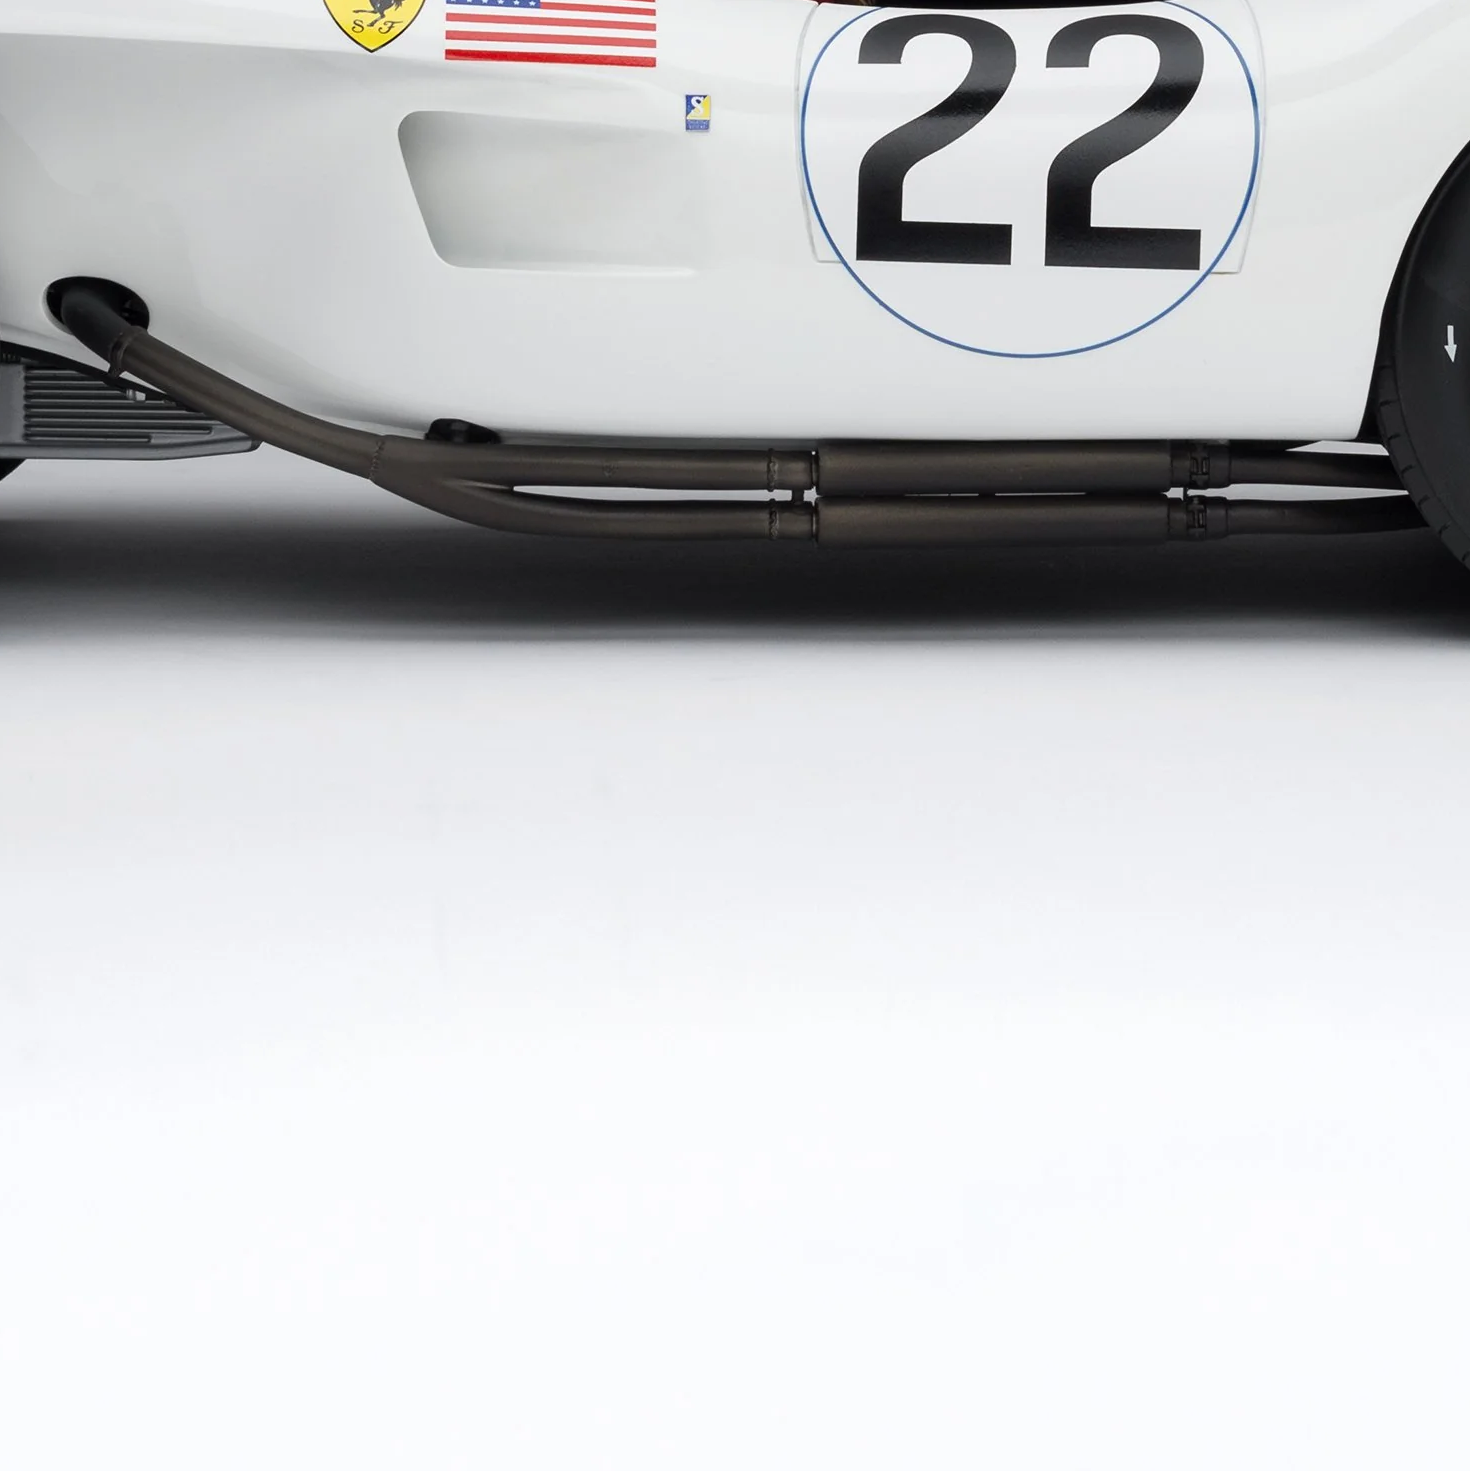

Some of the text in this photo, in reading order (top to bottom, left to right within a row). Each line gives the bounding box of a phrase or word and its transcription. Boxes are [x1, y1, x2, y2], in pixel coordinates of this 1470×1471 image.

[351, 18, 403, 35] S F
[856, 13, 1204, 271] 22
